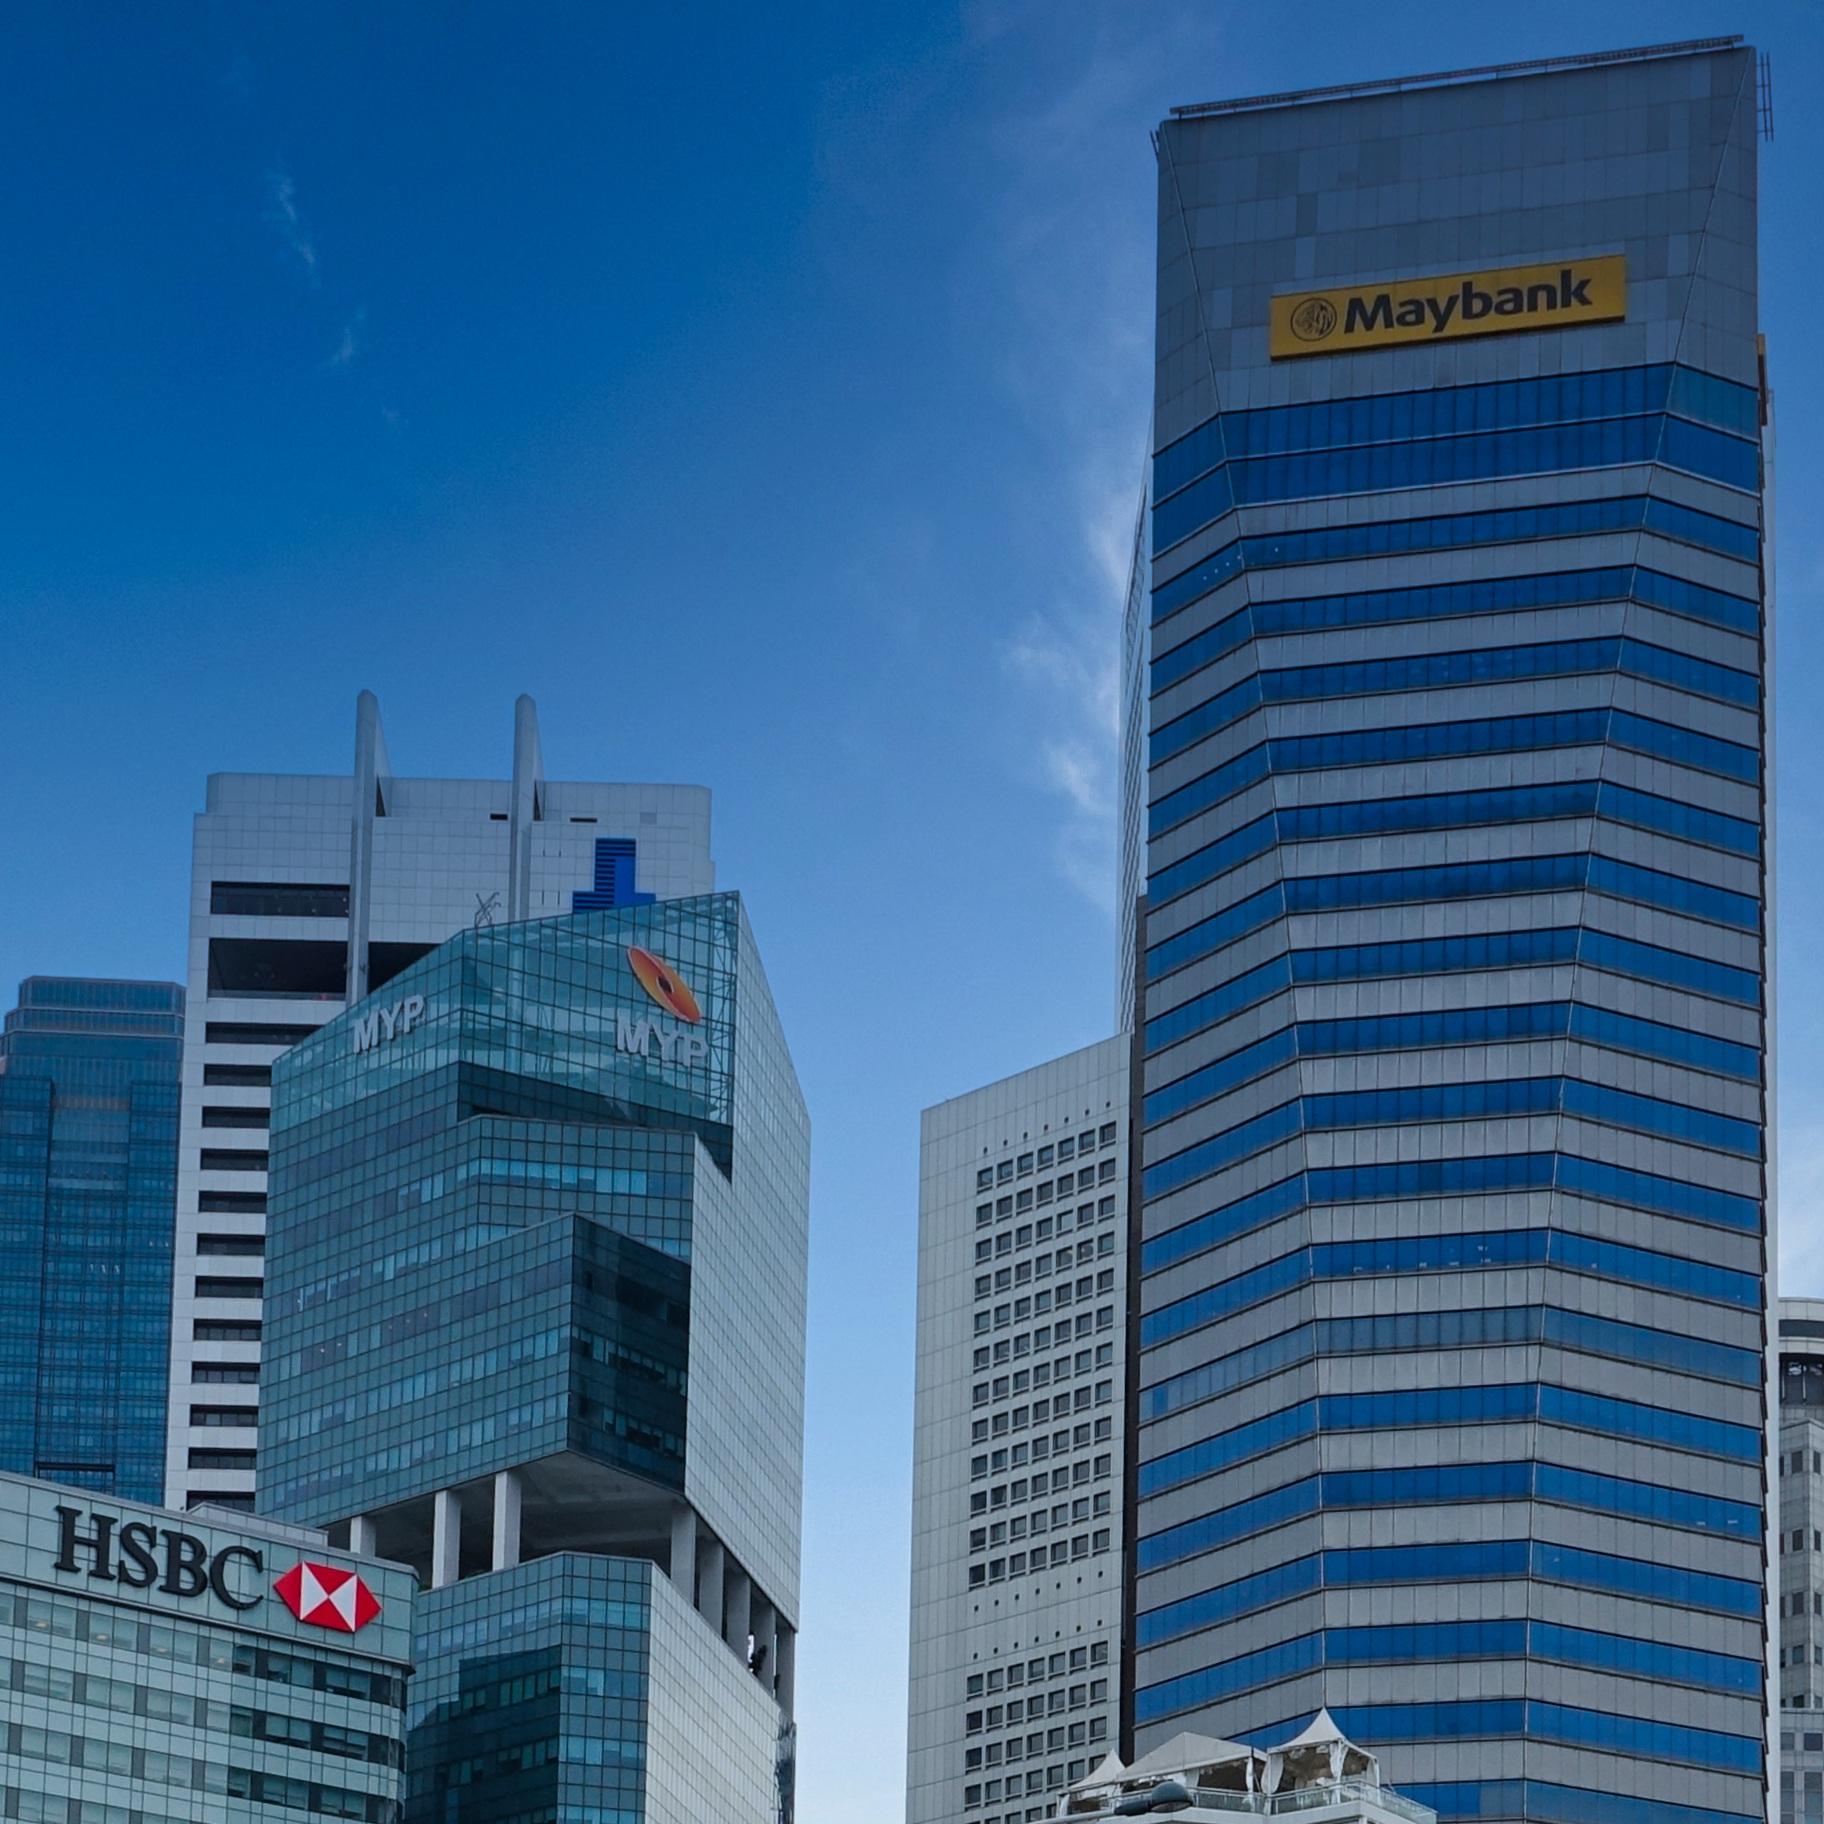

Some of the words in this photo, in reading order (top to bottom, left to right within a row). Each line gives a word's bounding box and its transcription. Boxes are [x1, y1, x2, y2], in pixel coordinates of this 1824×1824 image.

[1343, 268, 1594, 334] Maybank
[353, 994, 425, 1053] MYP
[615, 1010, 709, 1067] MYP
[53, 1504, 265, 1611] HSBC
